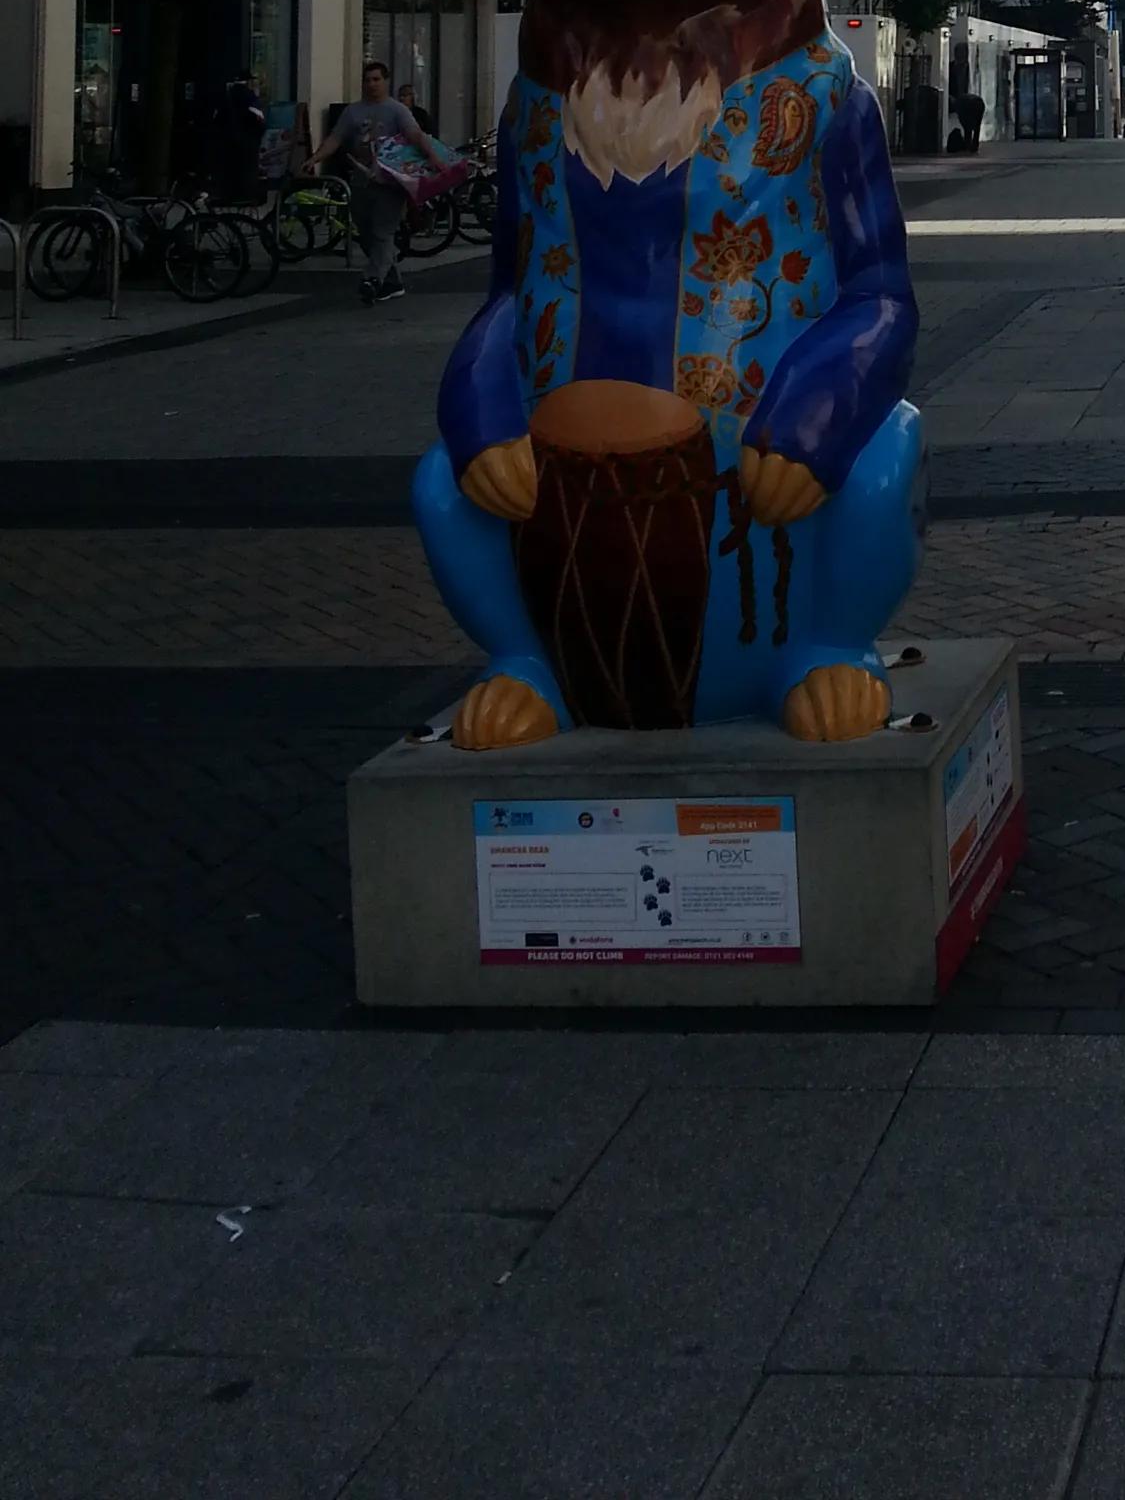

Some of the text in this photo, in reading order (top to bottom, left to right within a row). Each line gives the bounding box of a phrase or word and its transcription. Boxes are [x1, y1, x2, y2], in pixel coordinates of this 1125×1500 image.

[706, 849, 753, 863] next
[527, 951, 624, 960] PLEASE DO NOT CLIMB
